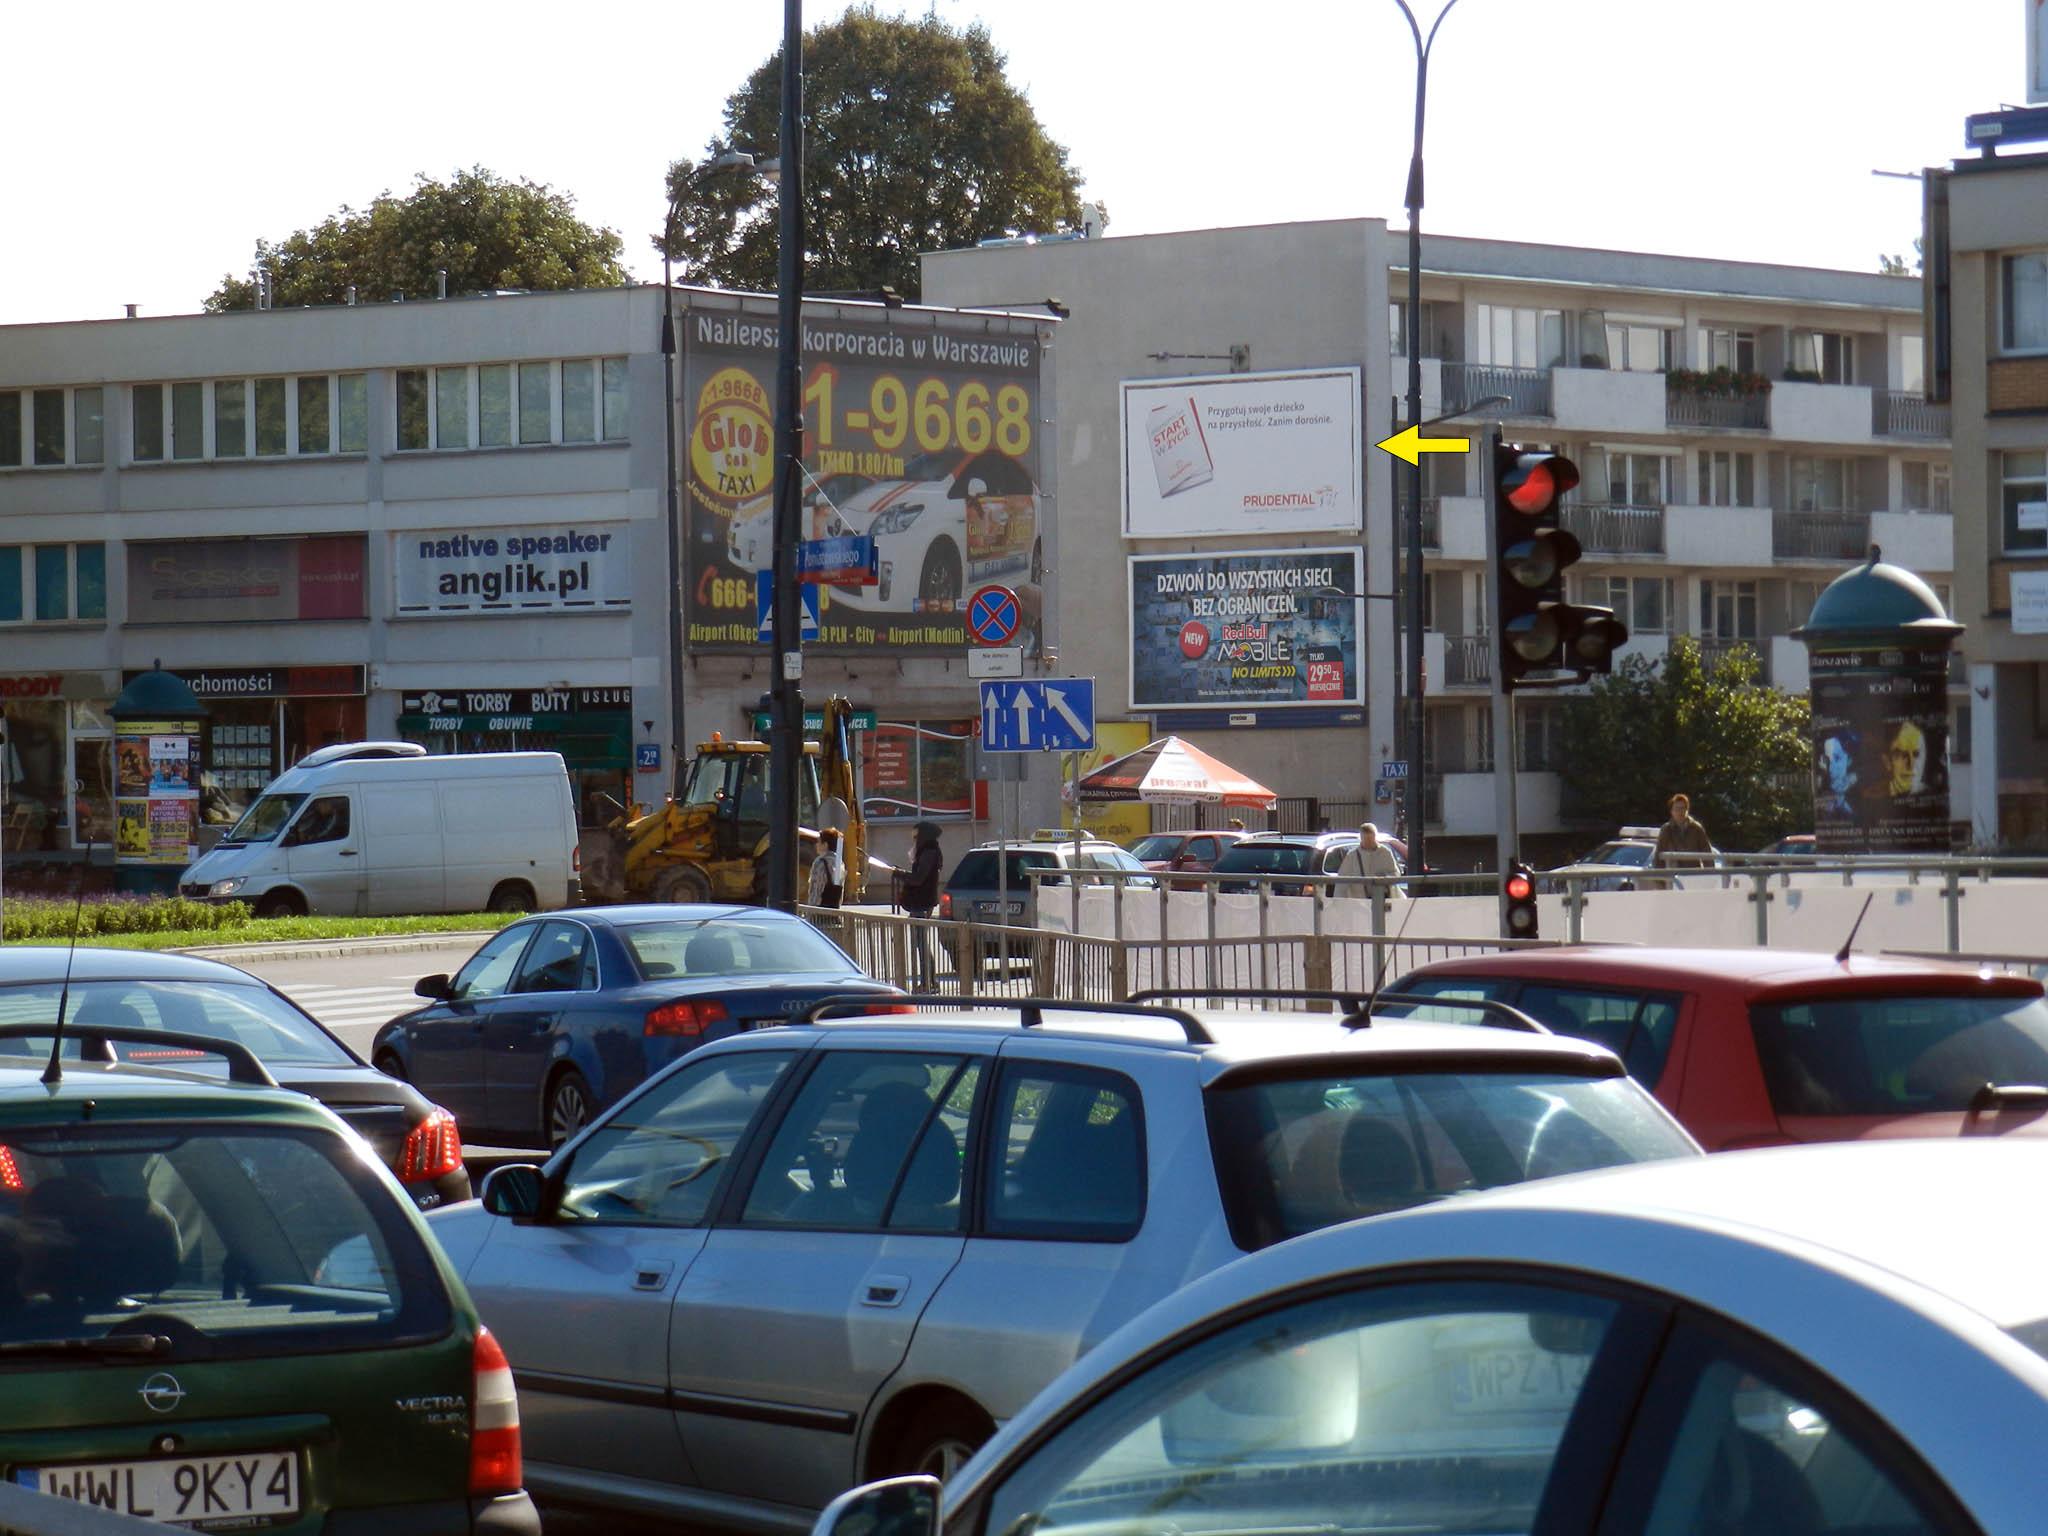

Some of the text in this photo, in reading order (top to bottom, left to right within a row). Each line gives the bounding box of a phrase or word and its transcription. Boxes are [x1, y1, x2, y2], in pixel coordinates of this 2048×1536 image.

[697, 316, 1030, 368] Najleps korporacja w Warszawie
[710, 379, 762, 404] 1-9668
[802, 366, 1032, 458] 1-9668
[1207, 402, 1305, 418] Przygotuj swoje dziecko
[702, 413, 769, 457] Glob
[1153, 415, 1187, 447] START
[1207, 420, 1218, 430] na
[818, 449, 854, 474] TYLKO
[716, 471, 757, 497] TAXI
[1243, 493, 1316, 507] PRUDENTIAL
[419, 529, 612, 561] native speaker
[439, 560, 589, 602] anglik.pl
[1156, 567, 1333, 593] DZWOŃ DO WSZYSTKICH SIECI
[1192, 590, 1299, 617] BEZ OGRANICZEŃ.
[689, 623, 727, 643] Airport
[855, 625, 876, 645] City
[887, 626, 923, 645] Airport
[1184, 631, 1204, 647] NEW
[1221, 622, 1269, 641] Red Bull
[1217, 640, 1292, 662] MOBILE
[1309, 652, 1325, 662] TYLKO
[183, 672, 273, 694] uchomości
[1231, 665, 1281, 679] NO LIMITS
[465, 689, 631, 712] TORBY BUTY USŁUG
[428, 716, 534, 731] TORBY OBUWIE
[1383, 763, 1408, 777] TAXI
[395, 1395, 467, 1411] VECTRA
[48, 1457, 293, 1519] WWL 9KY4
